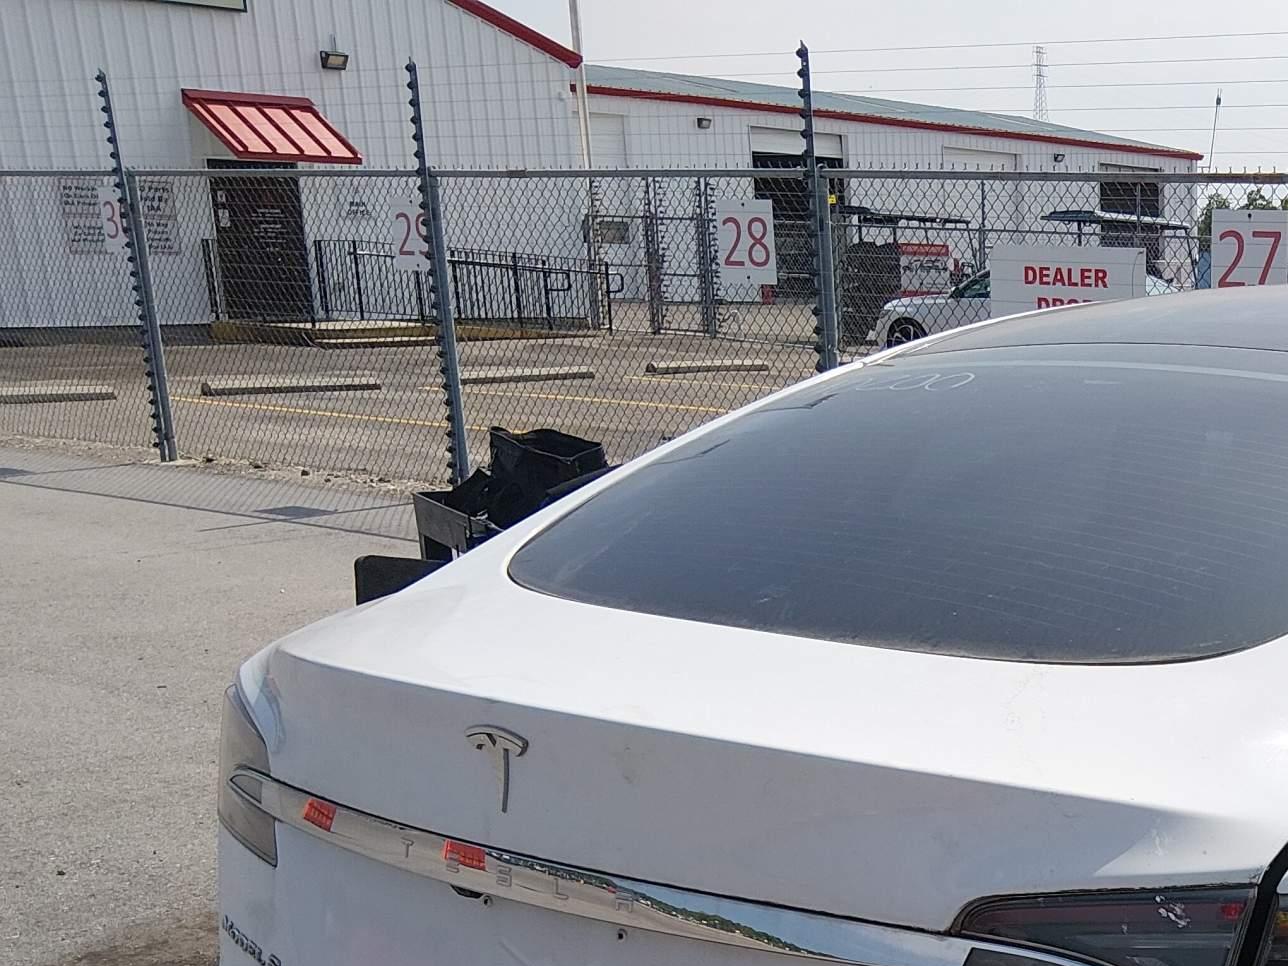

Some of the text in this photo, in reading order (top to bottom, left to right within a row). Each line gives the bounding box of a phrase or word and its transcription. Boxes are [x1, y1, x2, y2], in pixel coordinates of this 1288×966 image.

[722, 216, 771, 268] 28
[1217, 230, 1282, 288] 27
[1023, 265, 1109, 289] DEALER
